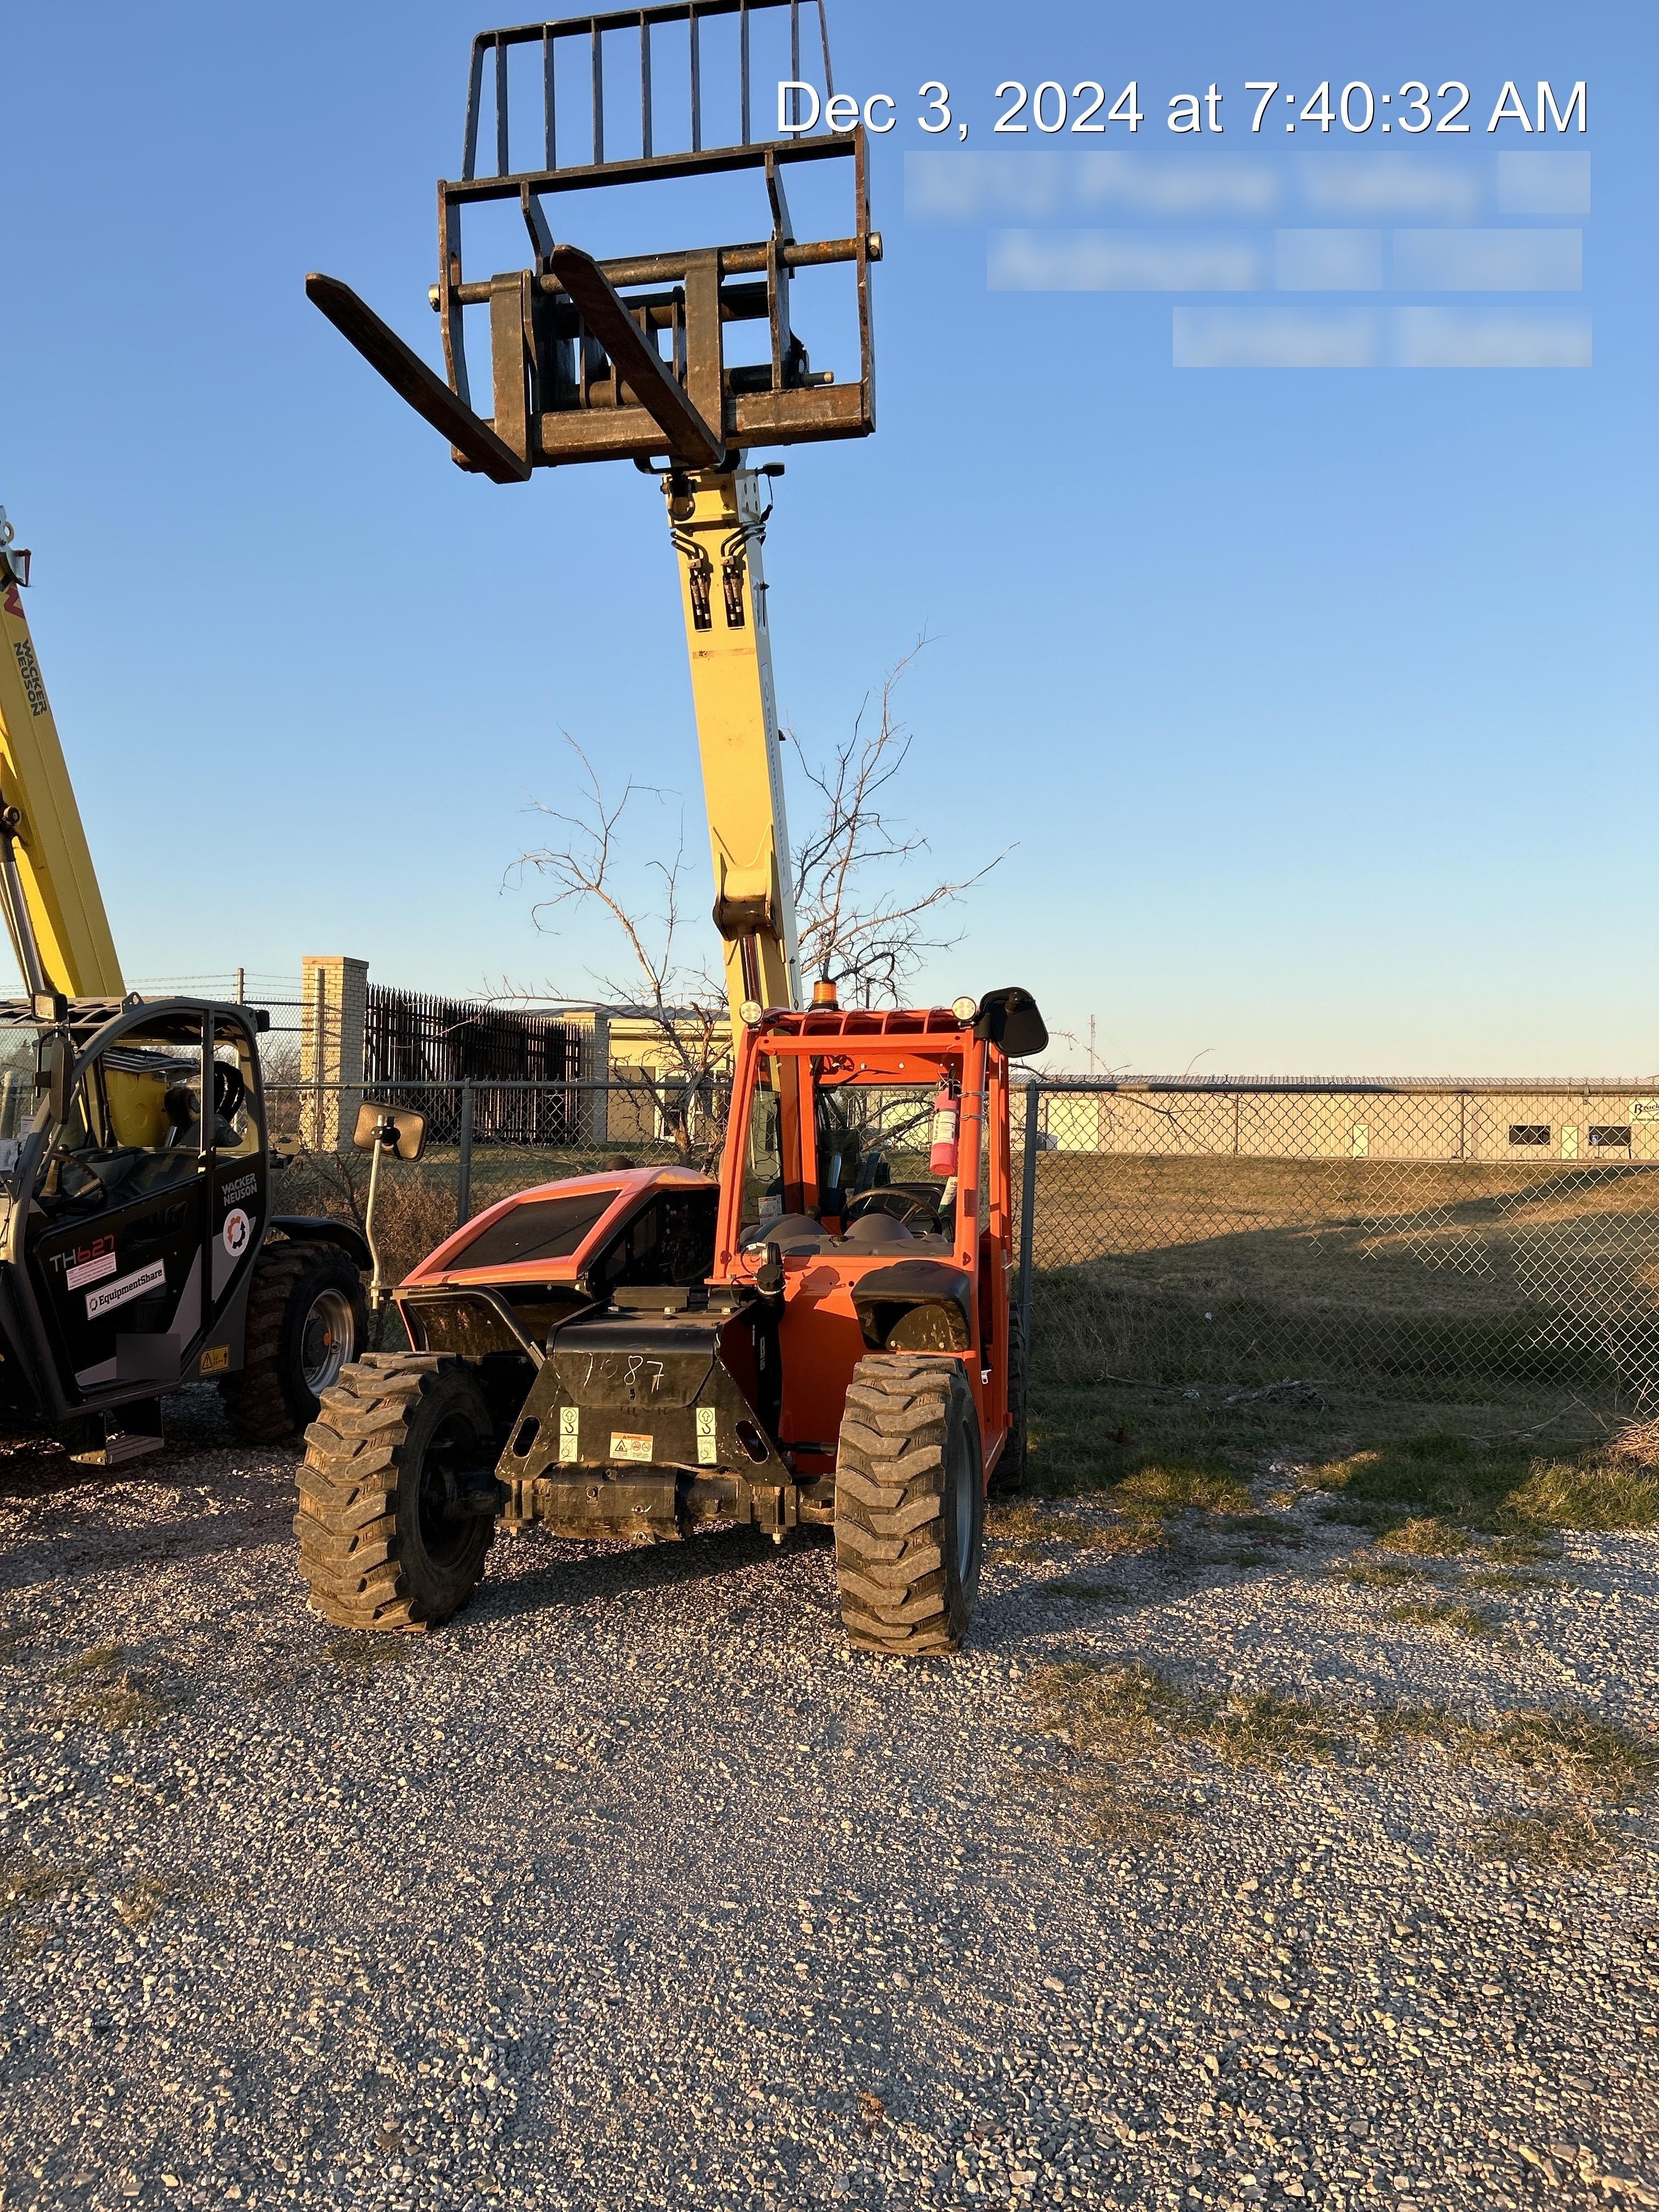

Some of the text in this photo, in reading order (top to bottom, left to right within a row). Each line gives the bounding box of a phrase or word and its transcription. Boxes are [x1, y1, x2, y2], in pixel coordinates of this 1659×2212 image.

[14, 641, 41, 717] NEUSON
[22, 638, 47, 715] WACKER
[221, 1173, 256, 1195] WACKER
[223, 1182, 257, 1206] NEUSON
[49, 1234, 115, 1272] TH627
[98, 1268, 163, 1306] EquipmentShare
